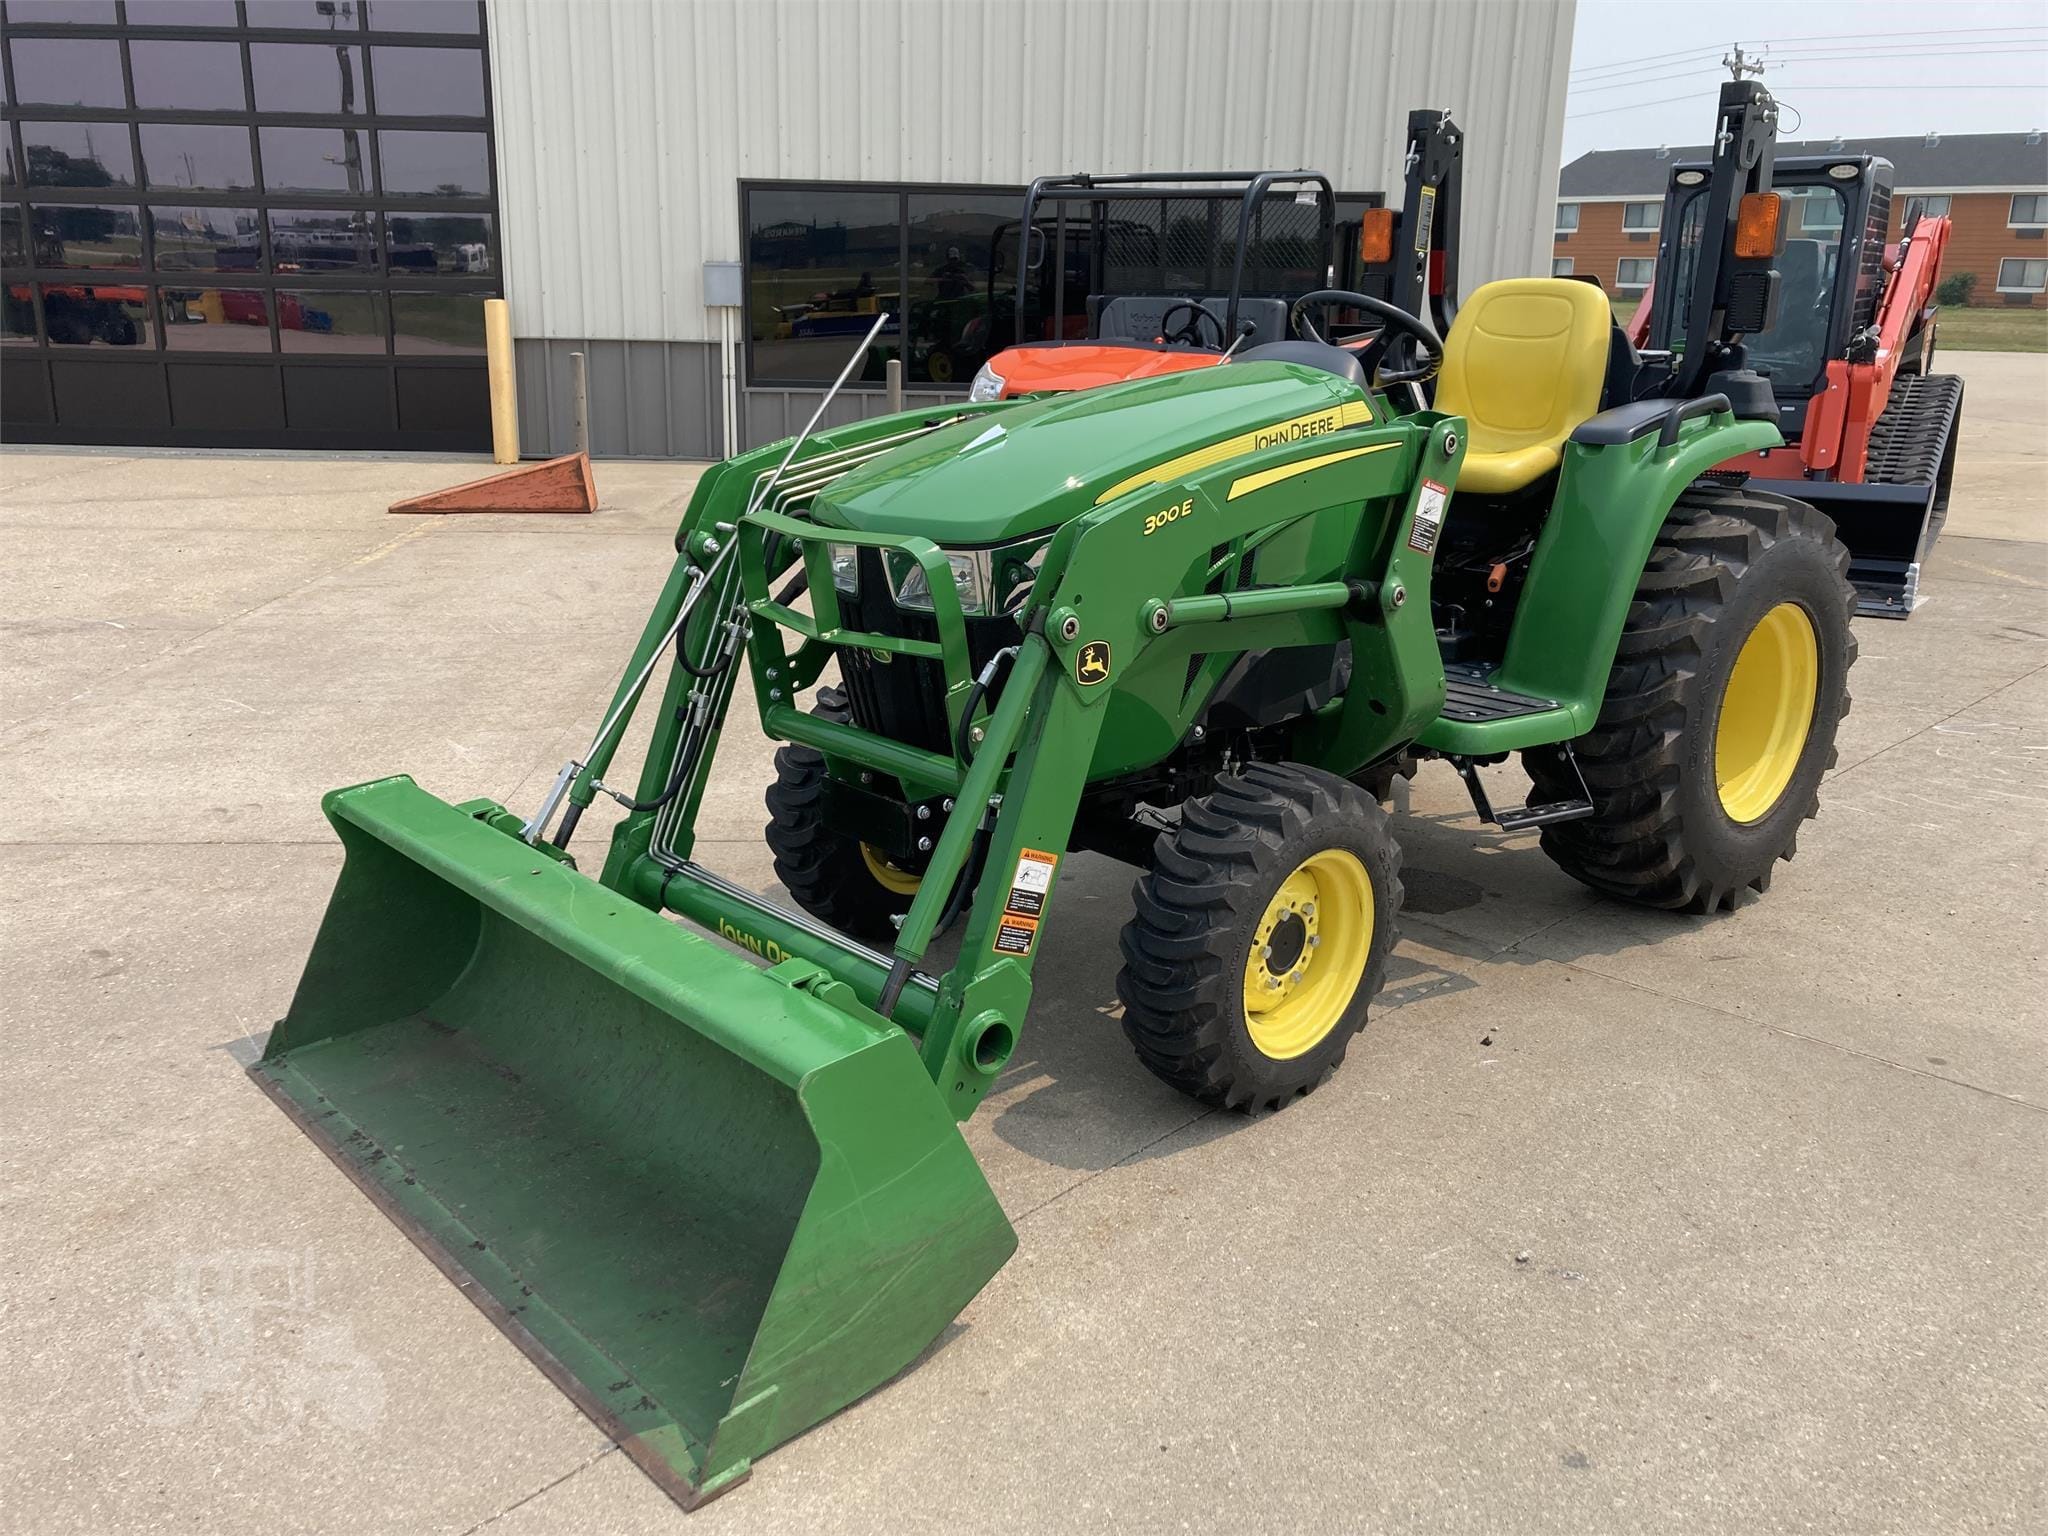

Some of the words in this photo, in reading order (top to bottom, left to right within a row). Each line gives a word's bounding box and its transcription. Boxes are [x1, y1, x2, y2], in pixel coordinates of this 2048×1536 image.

[1254, 429, 1289, 450] JOHN
[1291, 416, 1334, 441] DEERE
[1030, 852, 1053, 863] WARNING
[1011, 919, 1034, 929] WARNING
